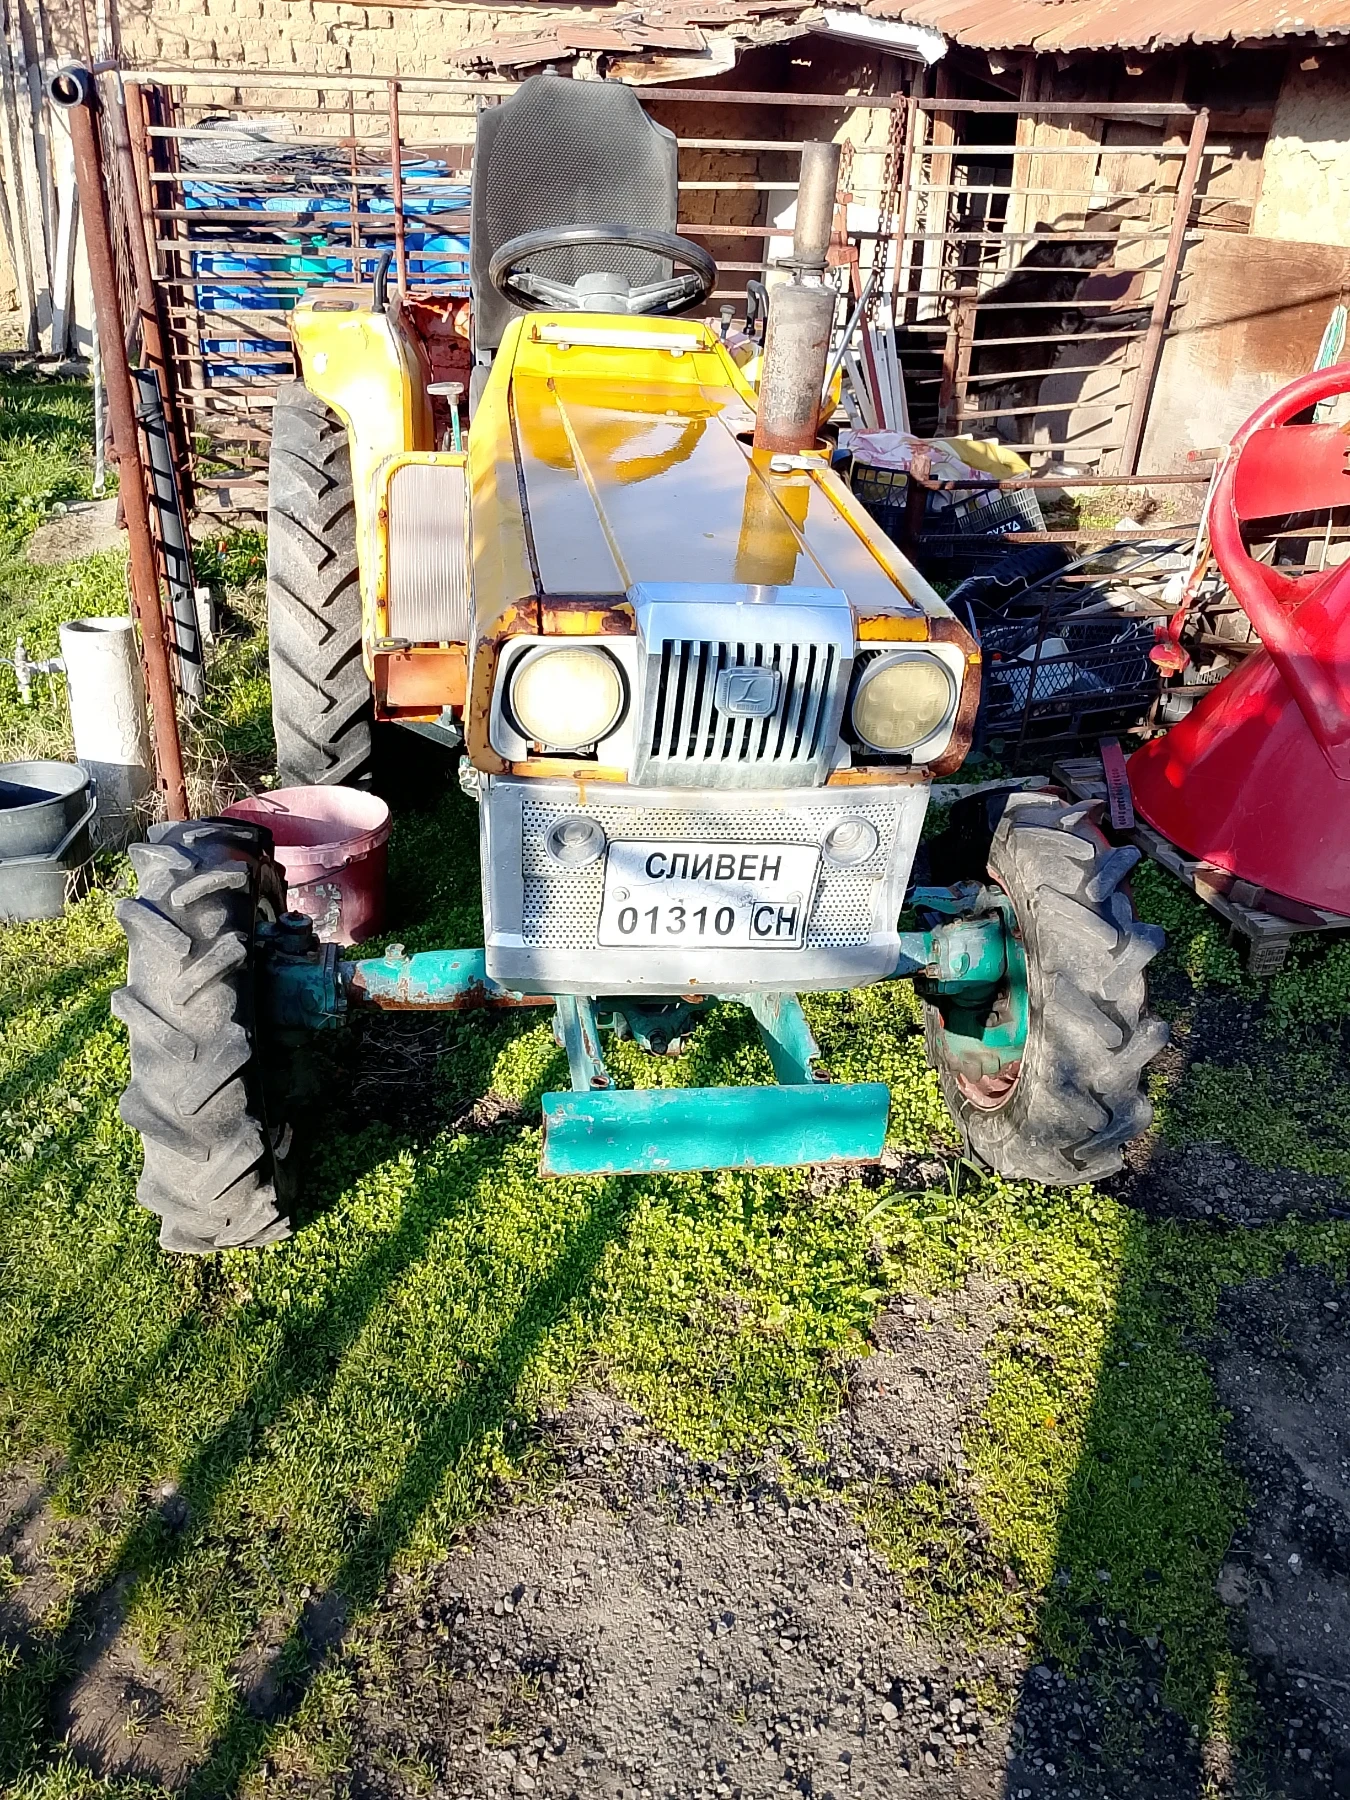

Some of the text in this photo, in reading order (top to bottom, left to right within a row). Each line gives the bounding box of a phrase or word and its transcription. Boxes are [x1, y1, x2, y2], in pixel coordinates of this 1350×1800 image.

[645, 852, 782, 881] СЛИВЕН
[617, 906, 797, 936] 01310 СН
